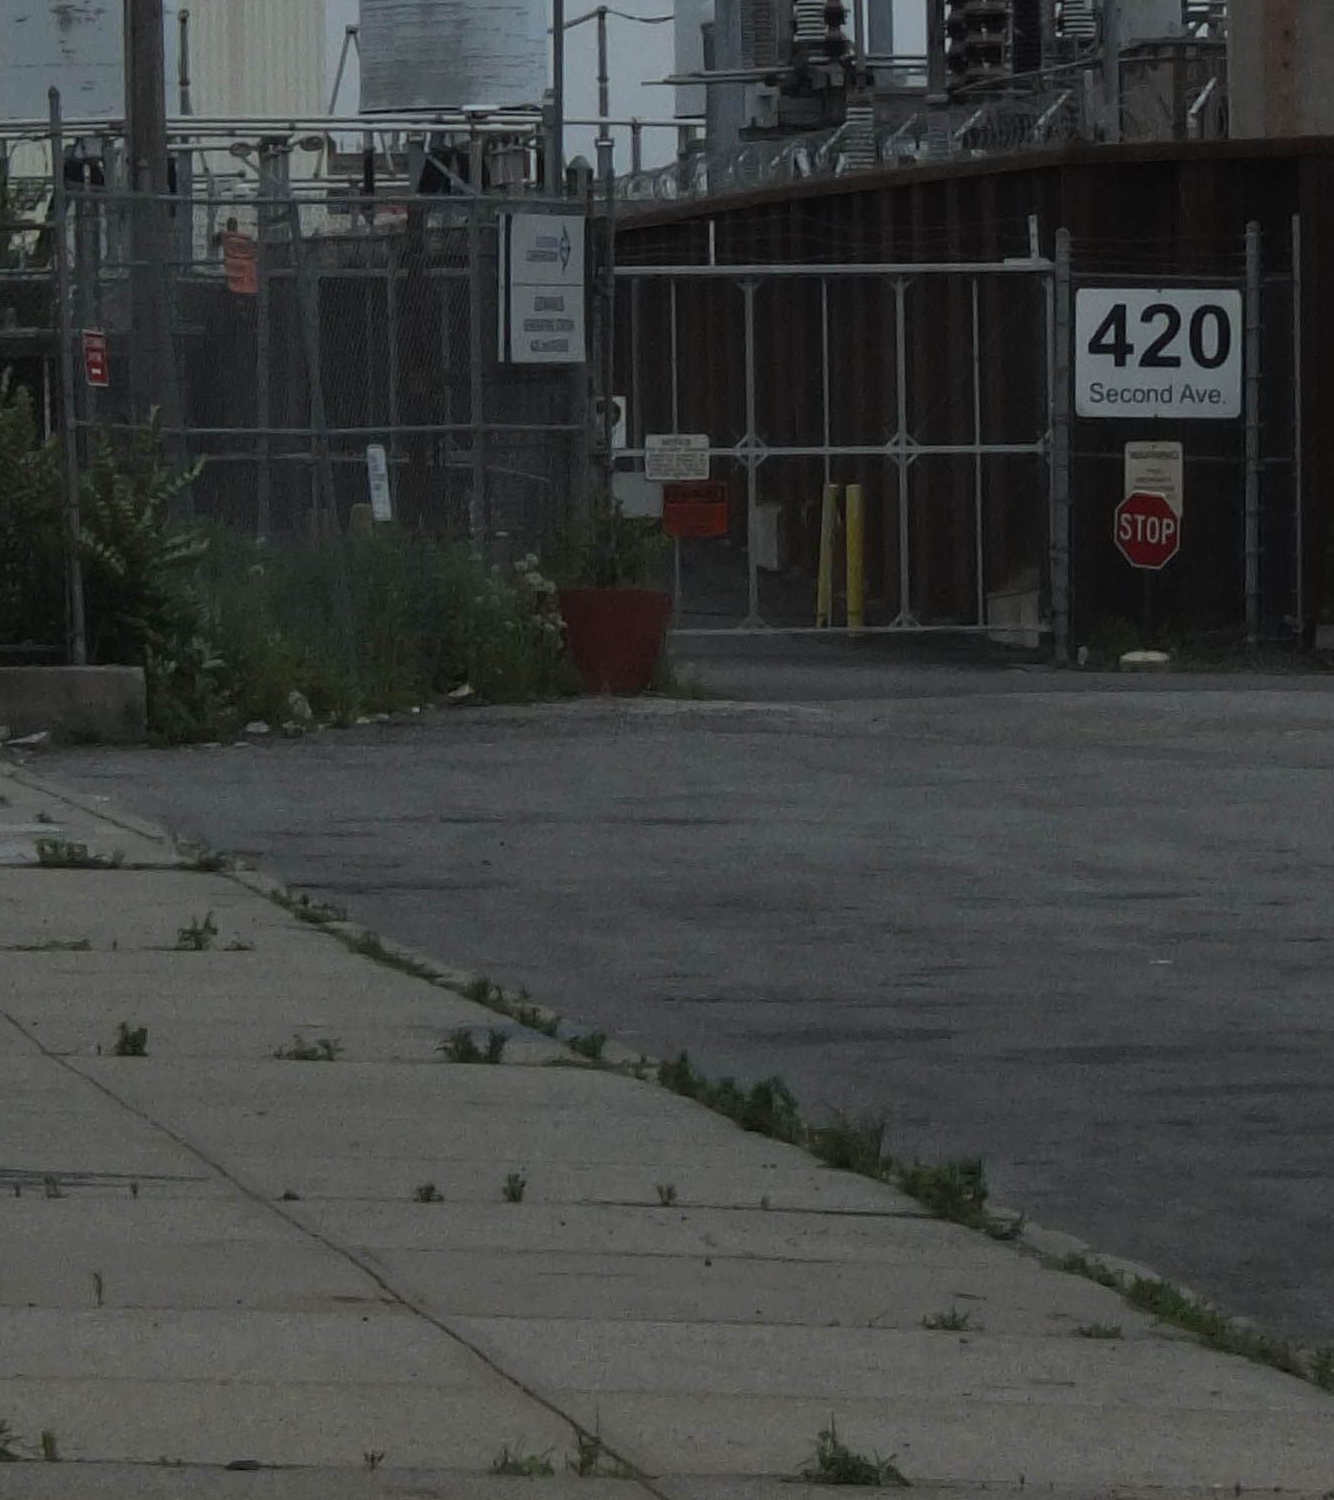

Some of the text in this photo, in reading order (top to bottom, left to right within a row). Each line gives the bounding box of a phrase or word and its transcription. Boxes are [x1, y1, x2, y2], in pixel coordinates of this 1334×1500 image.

[1087, 303, 1231, 369] 420
[1089, 382, 1227, 406] Second Ave.
[1119, 512, 1176, 546] STOP
